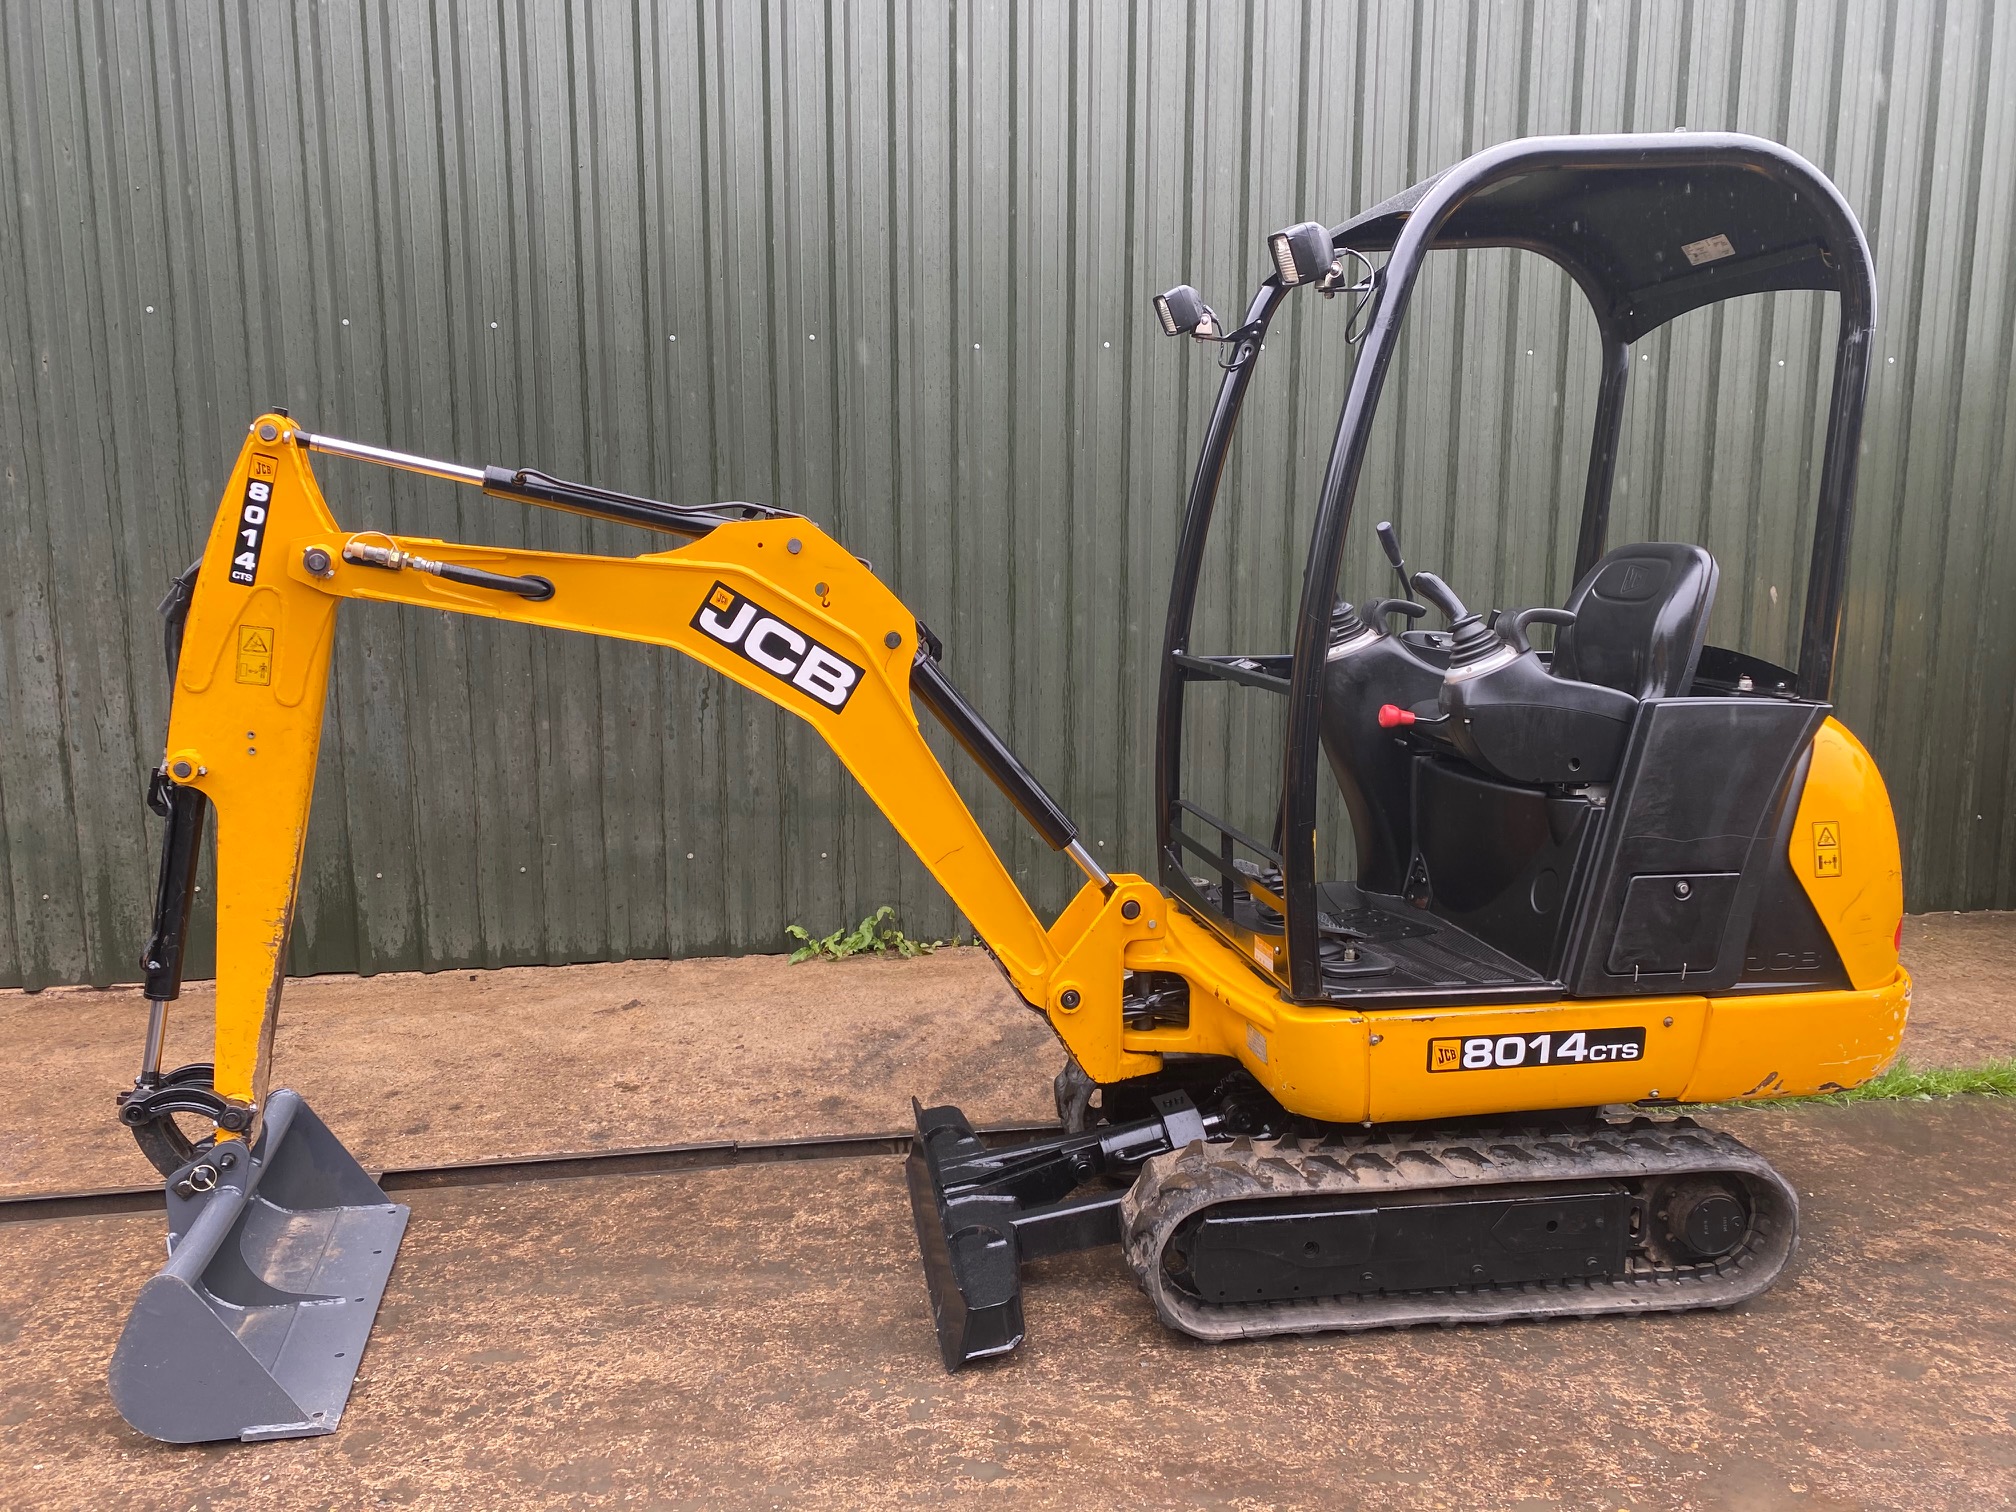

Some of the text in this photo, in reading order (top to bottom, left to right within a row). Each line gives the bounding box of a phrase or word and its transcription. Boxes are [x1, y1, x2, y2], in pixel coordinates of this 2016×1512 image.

[255, 461, 272, 475] JCB
[234, 482, 270, 571] 8014
[231, 570, 254, 581] CTS
[699, 602, 856, 706] JCB
[1437, 1032, 1639, 1069] JCB 8014 CTS
